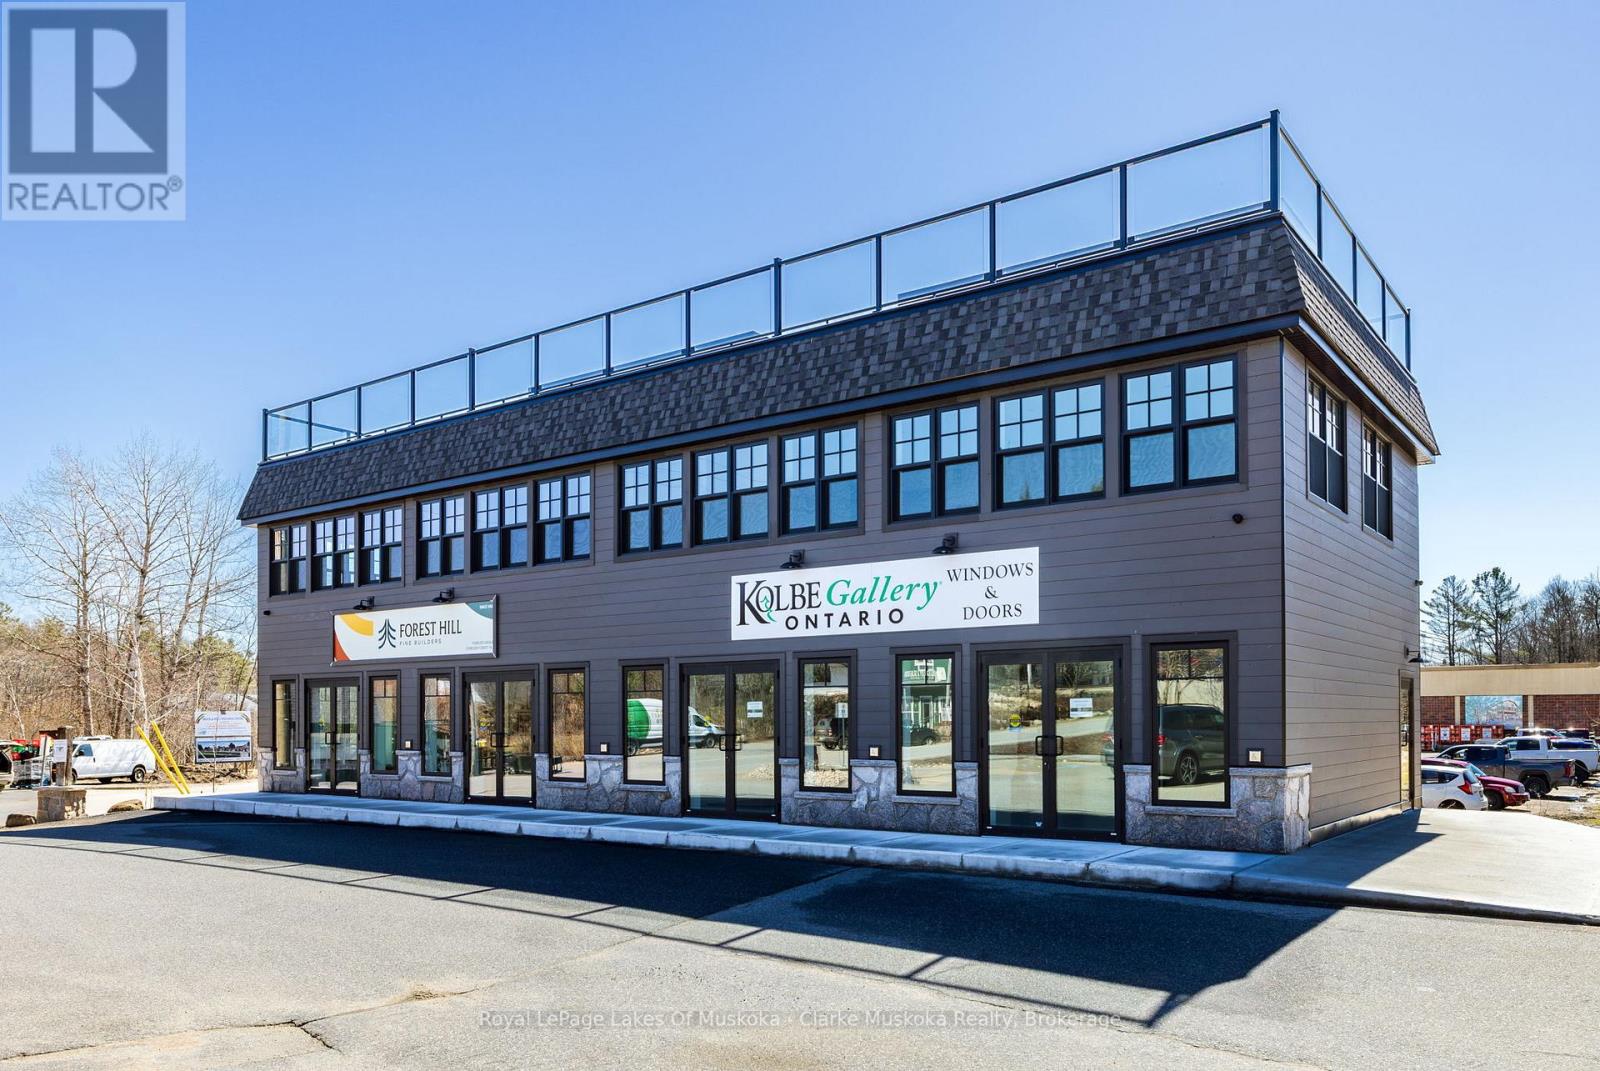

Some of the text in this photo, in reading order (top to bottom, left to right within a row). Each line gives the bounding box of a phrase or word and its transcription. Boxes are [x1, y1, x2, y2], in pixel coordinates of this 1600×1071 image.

[946, 562, 1034, 582] WINDOWS
[736, 575, 938, 627] KOLBE Gallery
[984, 585, 998, 600] &
[785, 608, 904, 631] ONTARIO
[963, 603, 1022, 620] DOORS
[399, 619, 462, 638] FOREST HILL
